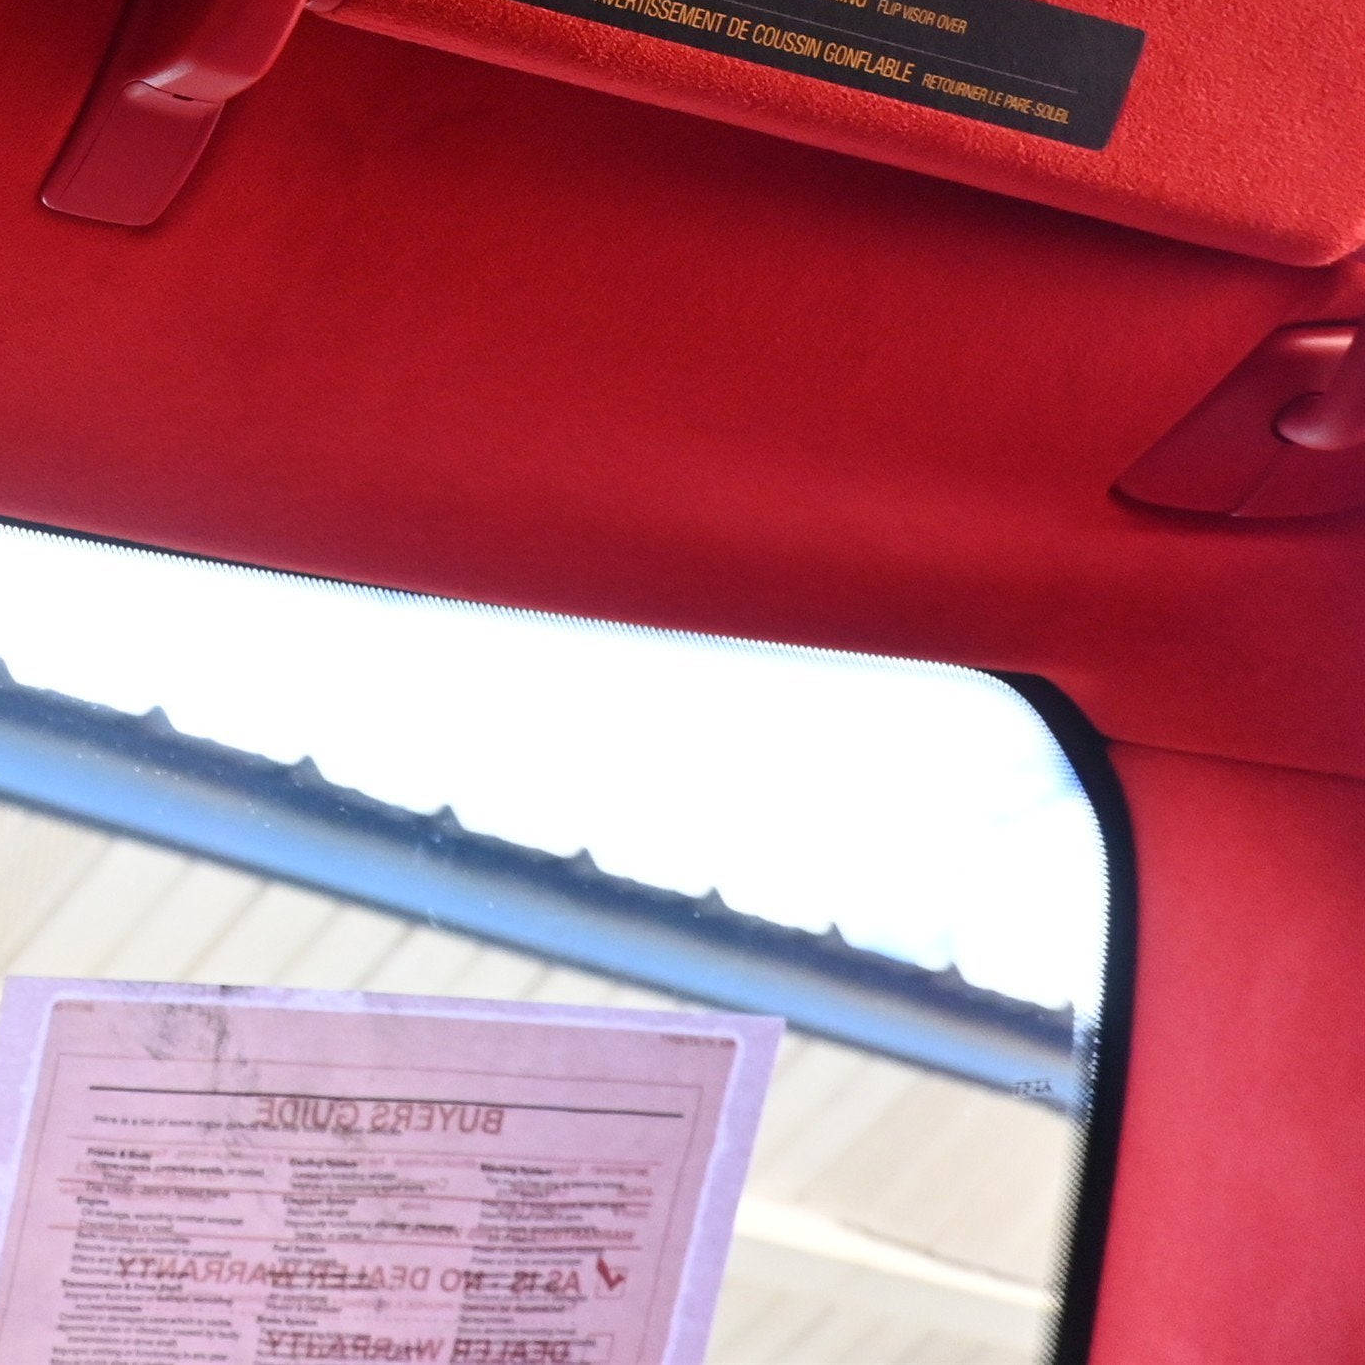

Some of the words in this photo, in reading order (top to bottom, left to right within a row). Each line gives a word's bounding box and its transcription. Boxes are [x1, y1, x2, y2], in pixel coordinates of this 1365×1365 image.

[903, 4, 936, 26] VISOR
[936, 14, 968, 35] OVER
[727, 17, 753, 41] DE
[752, 24, 823, 59] COUSSIN
[823, 42, 916, 84] GONFLABLE
[921, 73, 989, 104] RETOURNER
[987, 89, 1005, 107] LE
[1004, 94, 1070, 125] PARE-SOLEIL
